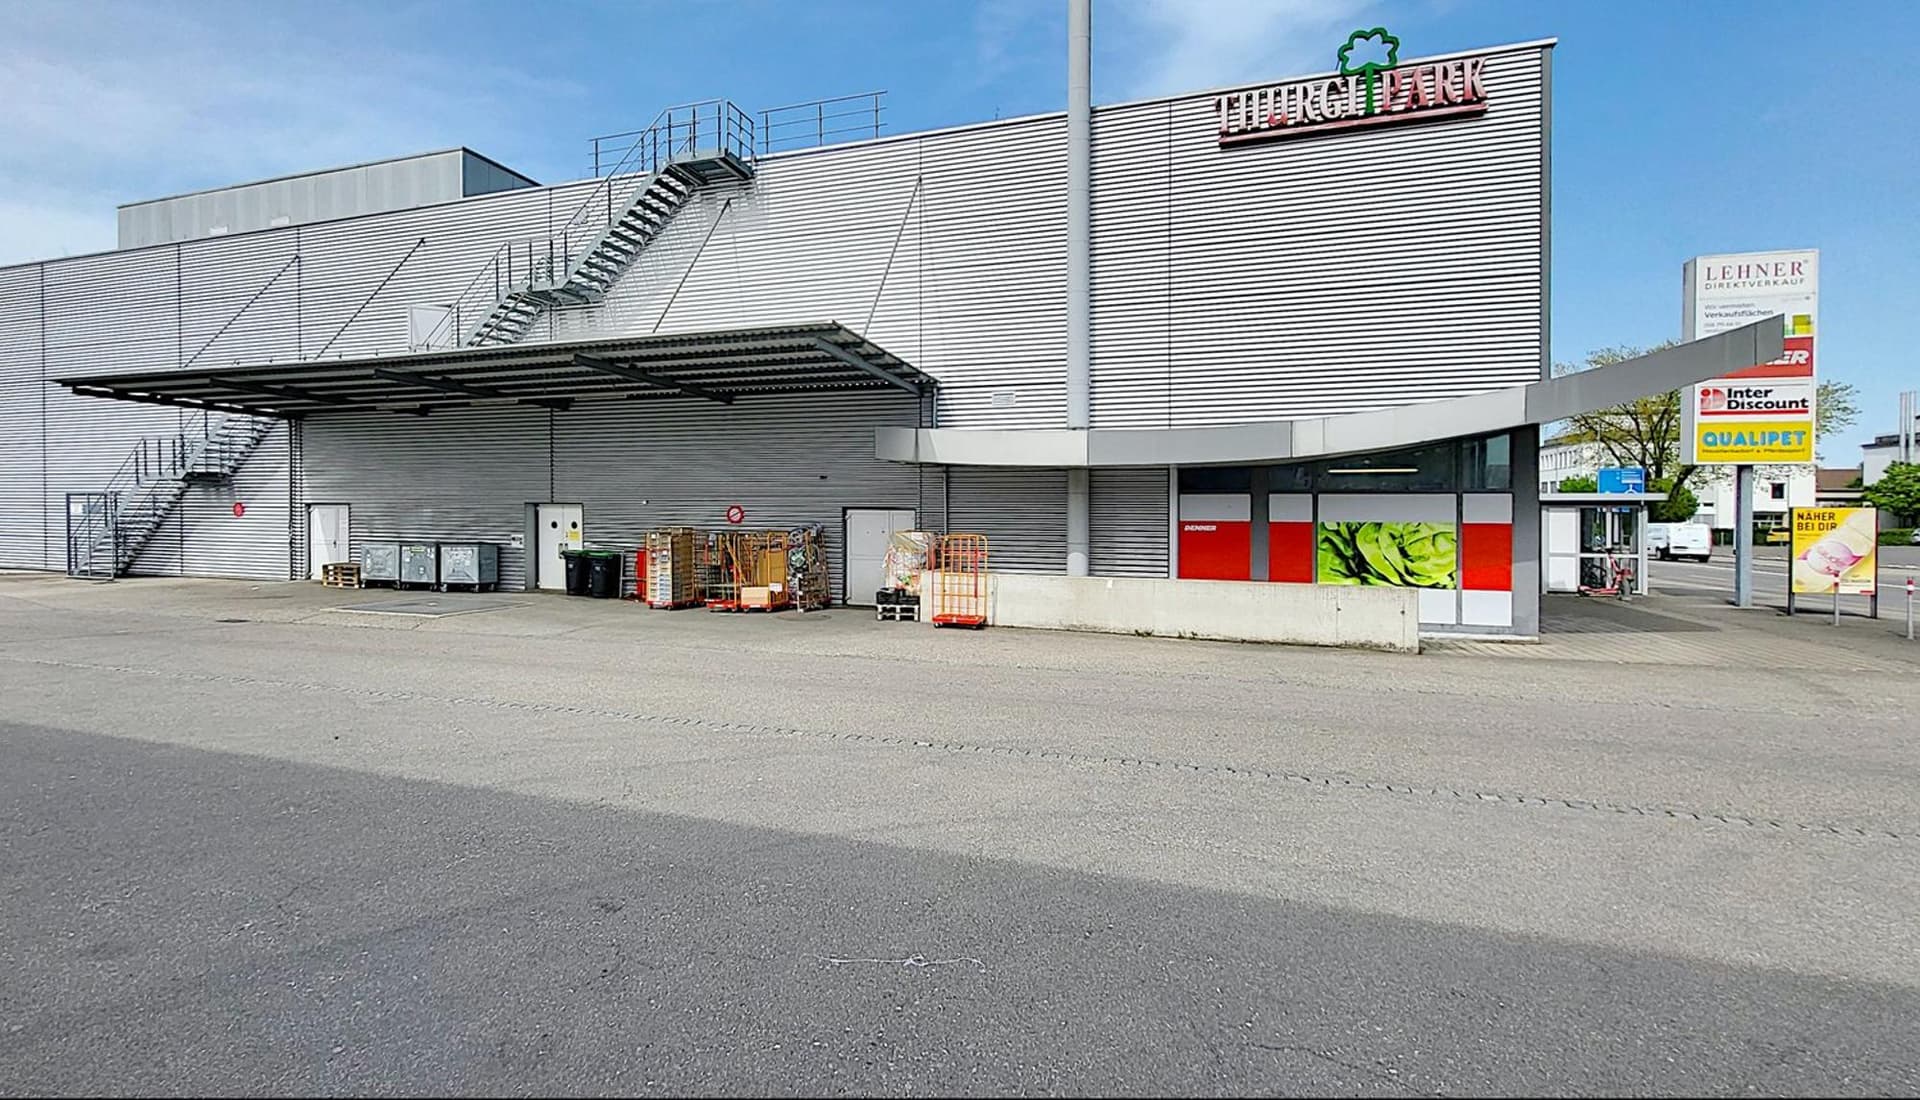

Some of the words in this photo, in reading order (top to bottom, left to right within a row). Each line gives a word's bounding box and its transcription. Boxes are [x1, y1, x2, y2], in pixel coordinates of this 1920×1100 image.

[1381, 57, 1489, 112] PARK
[1704, 278, 1805, 290] DIREKTVERKAUF
[1704, 309, 1774, 318] Verkaufsflächen
[1727, 388, 1773, 398] Inter
[1727, 397, 1809, 409] Discount
[1702, 431, 1806, 446] QUALIPET
[1797, 522, 1815, 531] BEI
